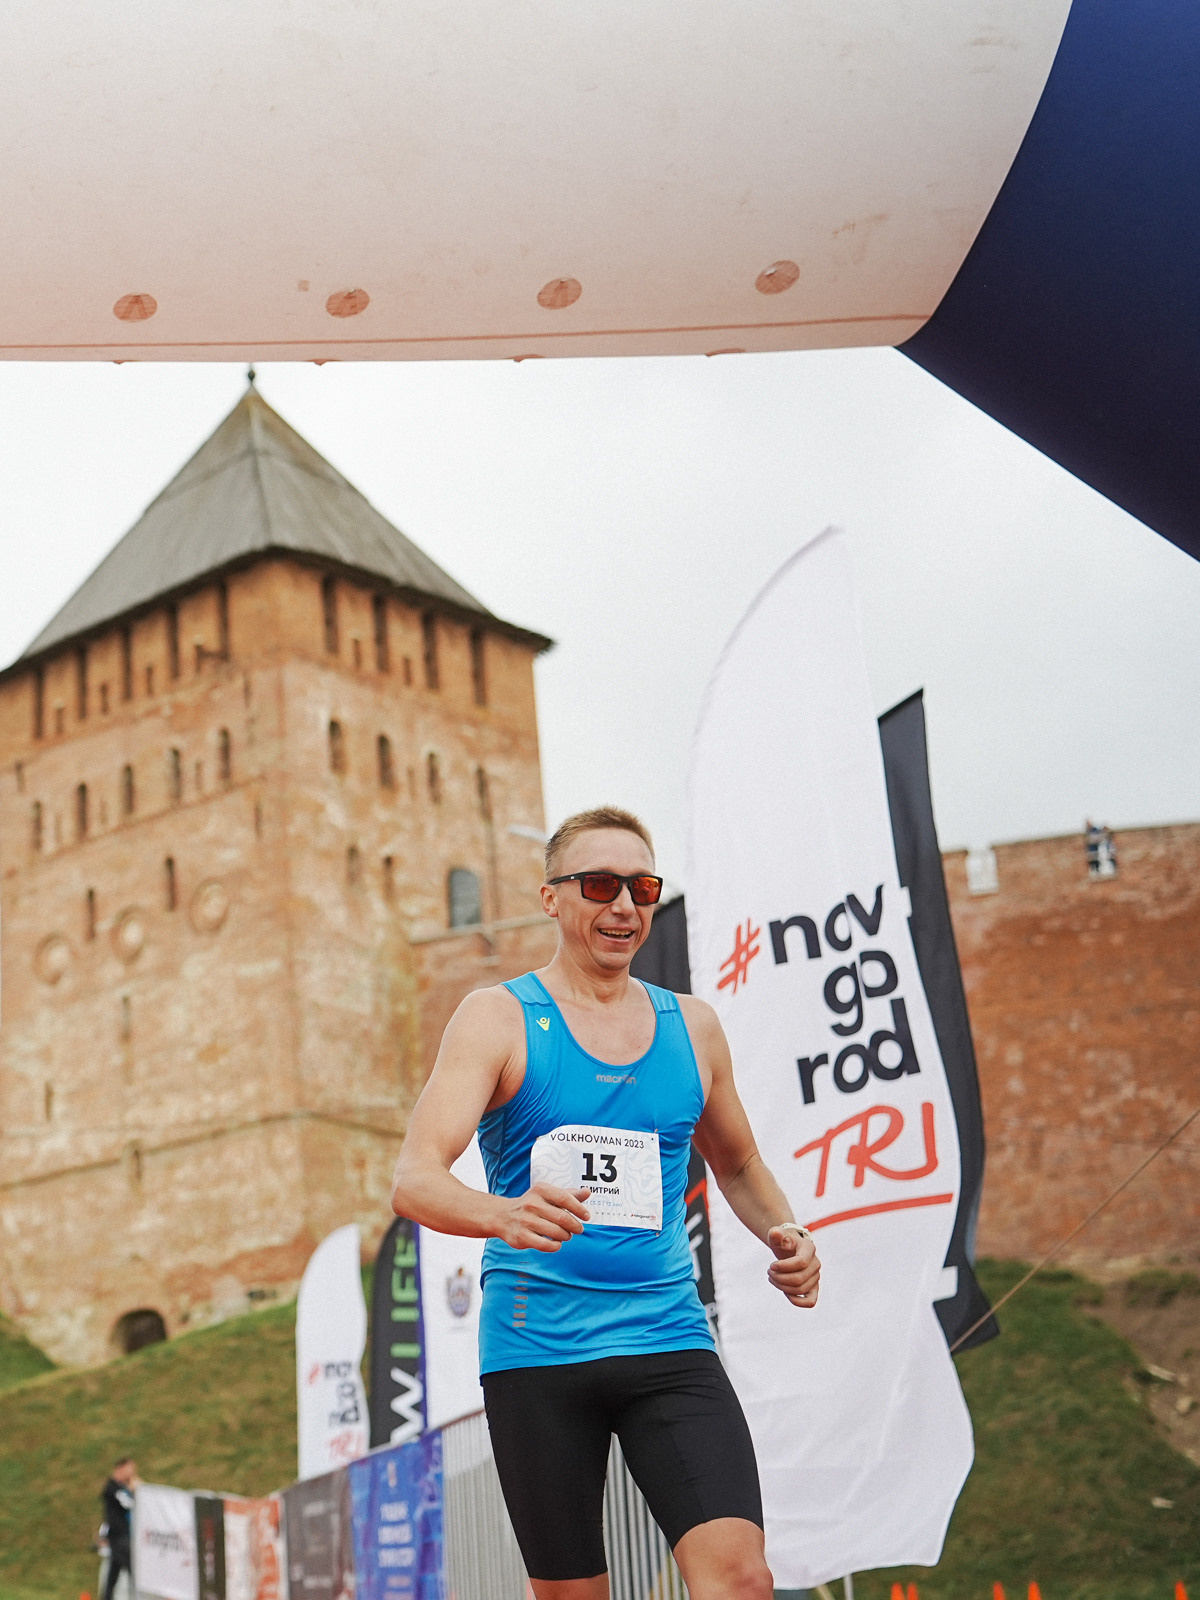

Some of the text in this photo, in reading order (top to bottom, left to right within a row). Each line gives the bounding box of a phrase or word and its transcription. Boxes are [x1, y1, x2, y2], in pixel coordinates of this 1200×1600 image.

[717, 882, 884, 994] #nov
[823, 949, 898, 1036] go
[797, 997, 921, 1105] rod
[551, 1133, 645, 1149] VOLKHOVMAN 2023
[581, 1153, 618, 1183] 13
[794, 1102, 938, 1198] TRI
